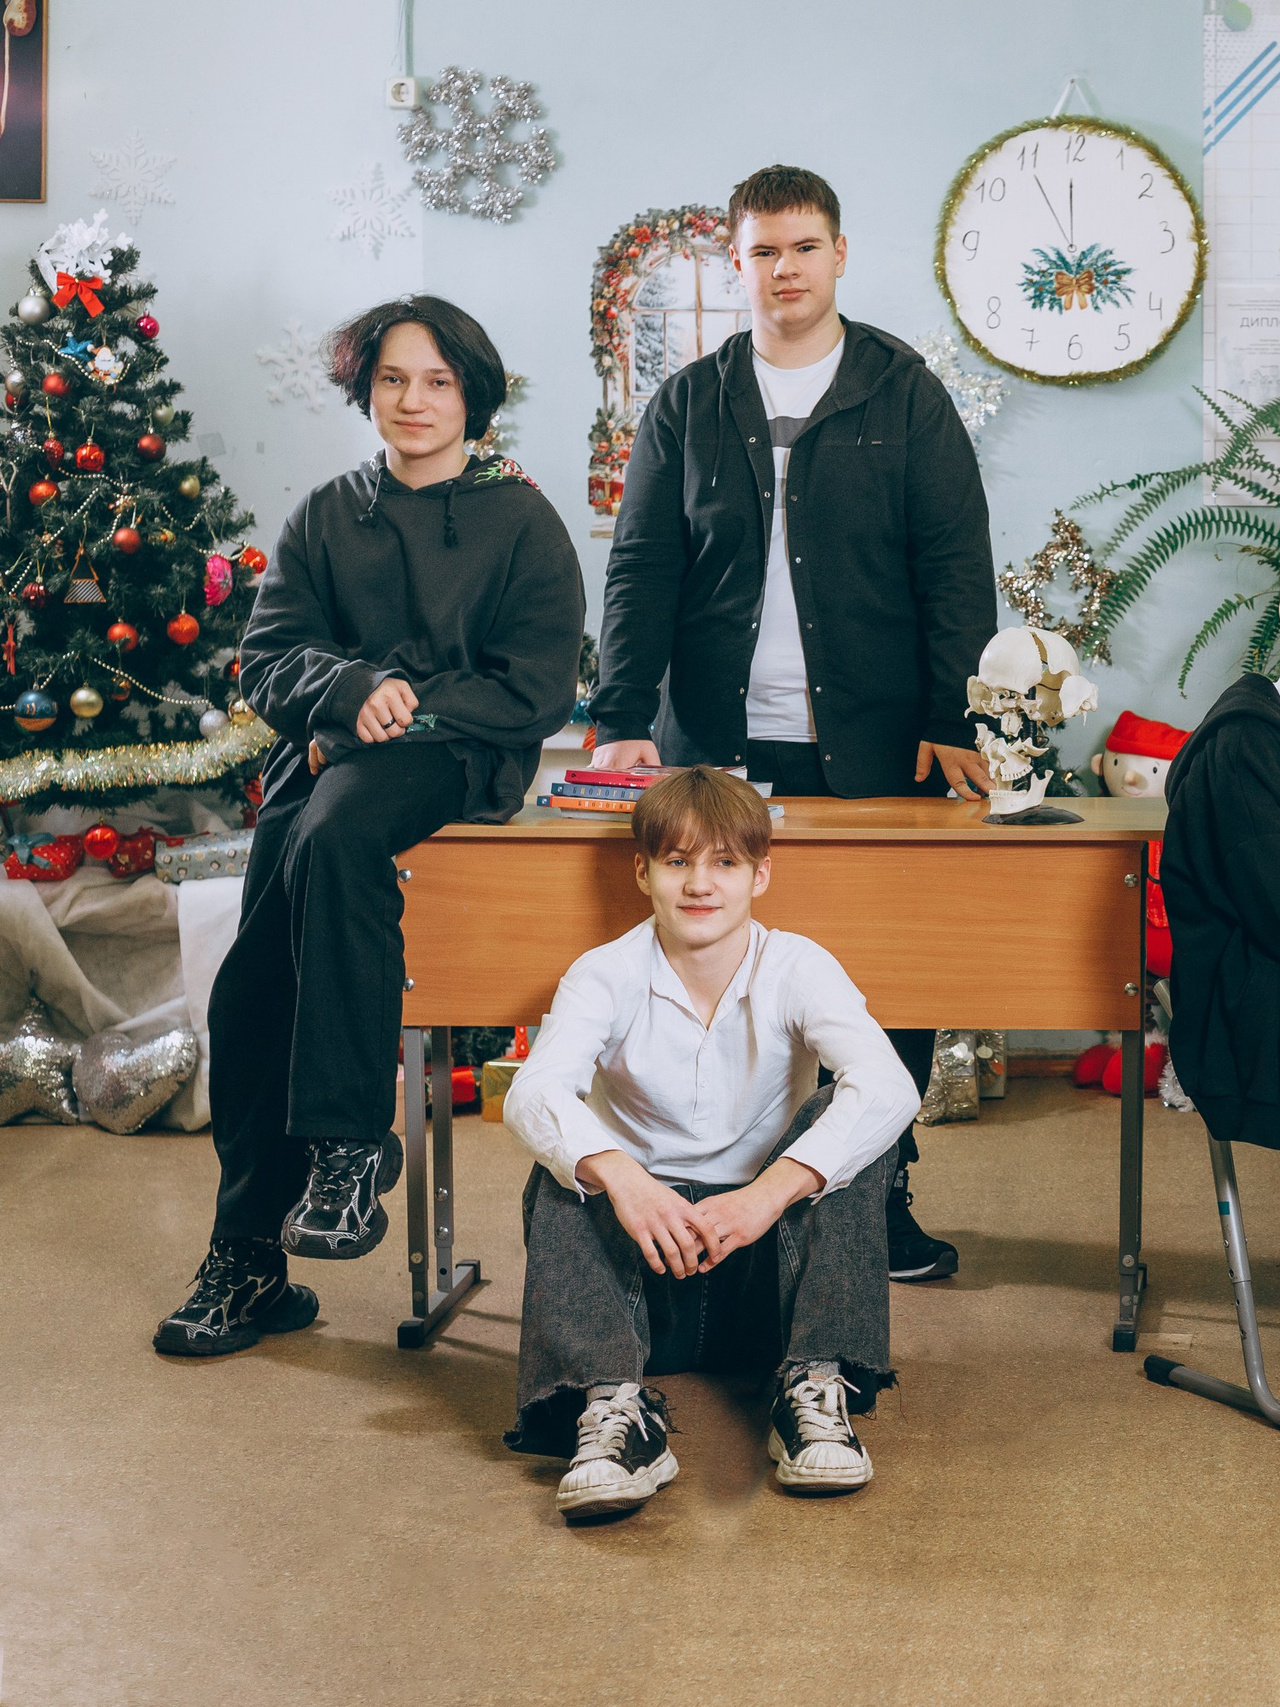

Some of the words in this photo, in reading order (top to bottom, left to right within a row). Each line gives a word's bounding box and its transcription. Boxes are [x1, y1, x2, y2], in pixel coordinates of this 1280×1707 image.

[1017, 141, 1039, 171] 11
[1065, 134, 1086, 164] 12
[1115, 146, 1124, 171] 1
[975, 177, 1006, 203] 10
[1138, 172, 1154, 200] 2
[962, 230, 980, 261] 9
[1159, 220, 1175, 254] 3
[986, 296, 1002, 329] 8
[1148, 291, 1163, 320] 4
[1021, 328, 1040, 351] 7
[1067, 334, 1083, 360] 6
[1114, 322, 1131, 351] 5
[572, 786, 635, 799] БИОЛОГИЯ
[578, 800, 631, 811] БИОЛОГИЯ
